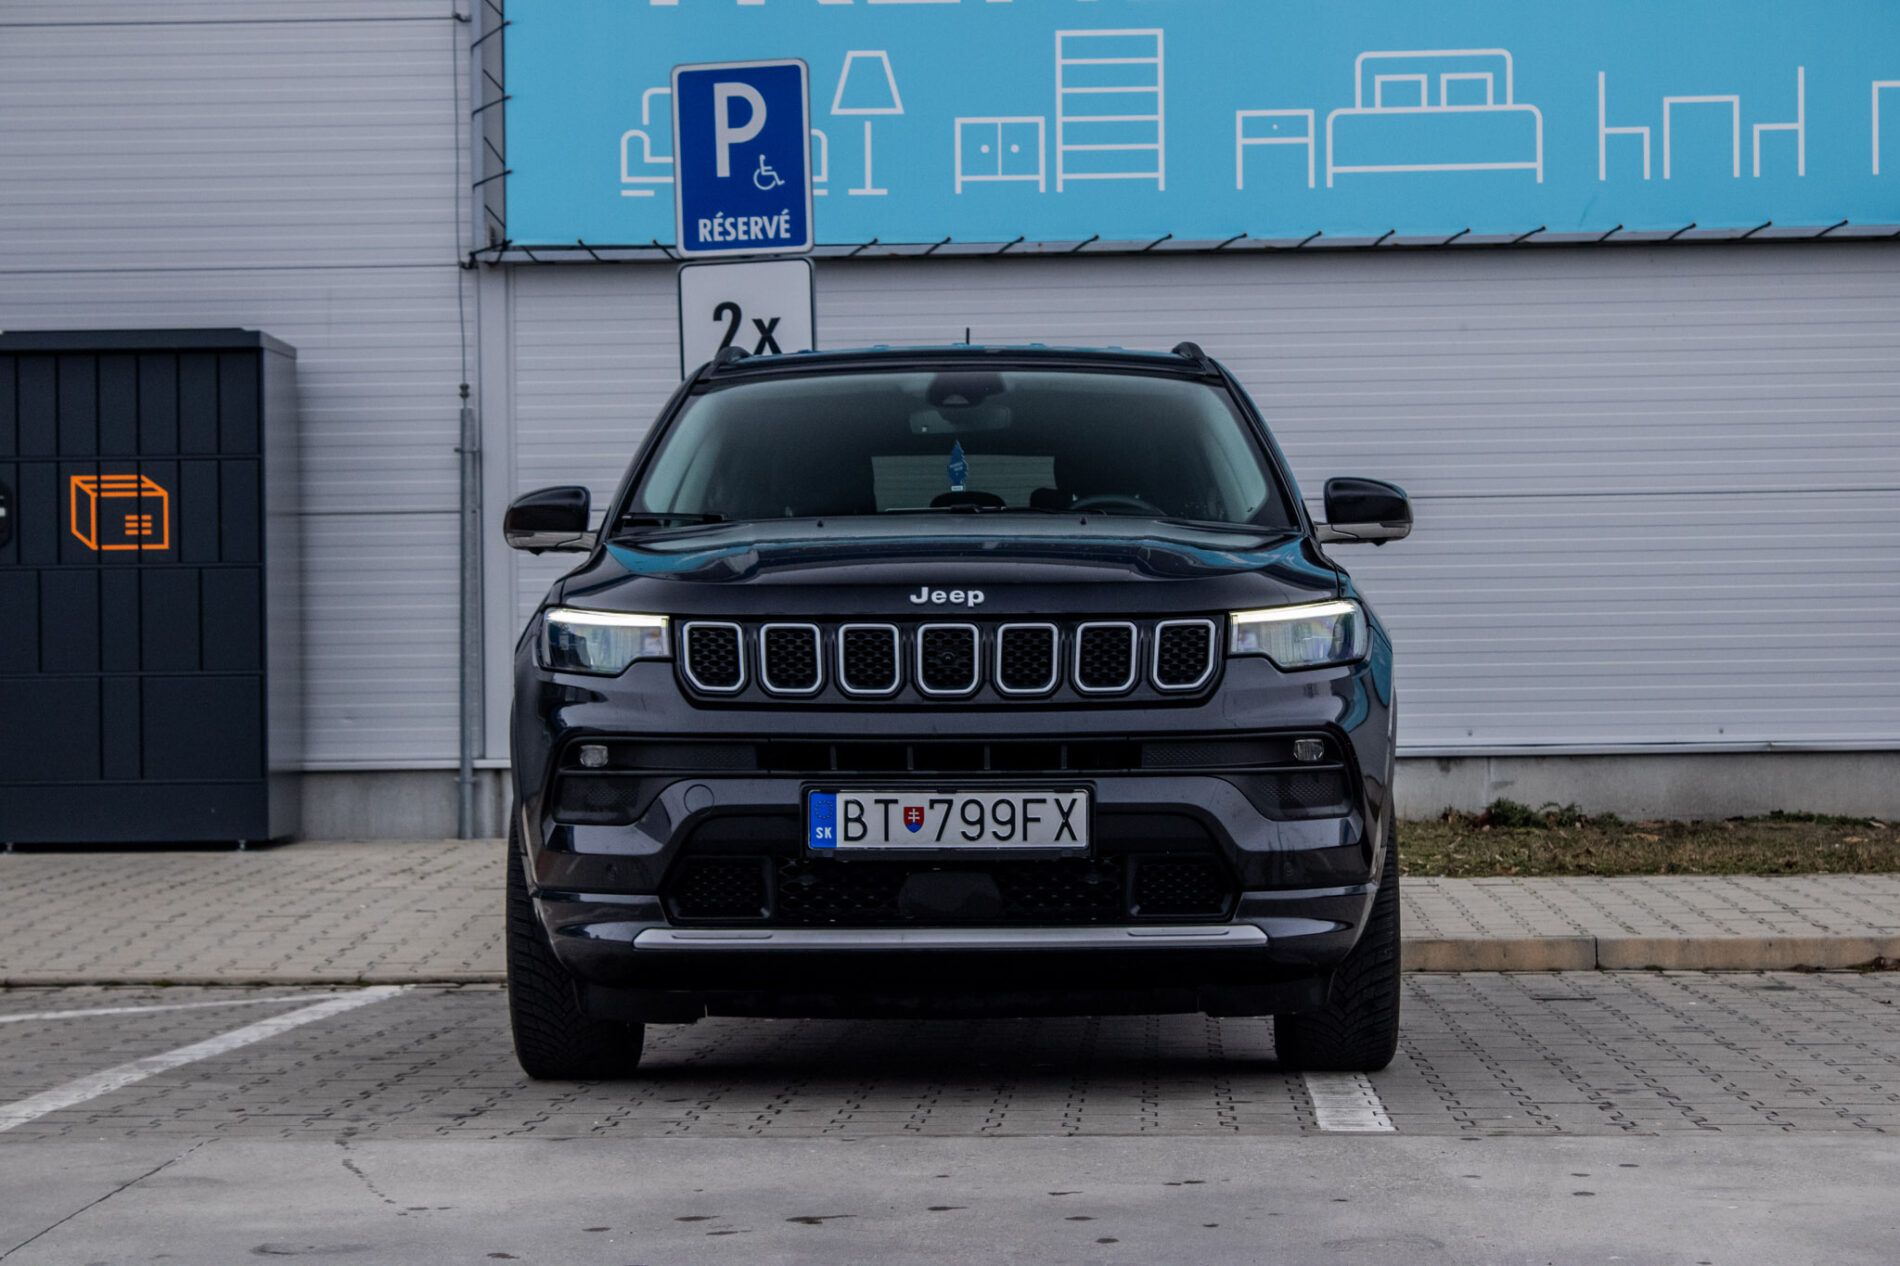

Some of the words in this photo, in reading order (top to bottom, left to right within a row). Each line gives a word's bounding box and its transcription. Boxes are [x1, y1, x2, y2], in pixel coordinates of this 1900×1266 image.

[713, 81, 767, 178] P
[698, 208, 791, 242] RÉSERVÉ
[909, 586, 985, 607] Jeep
[815, 826, 832, 839] SK
